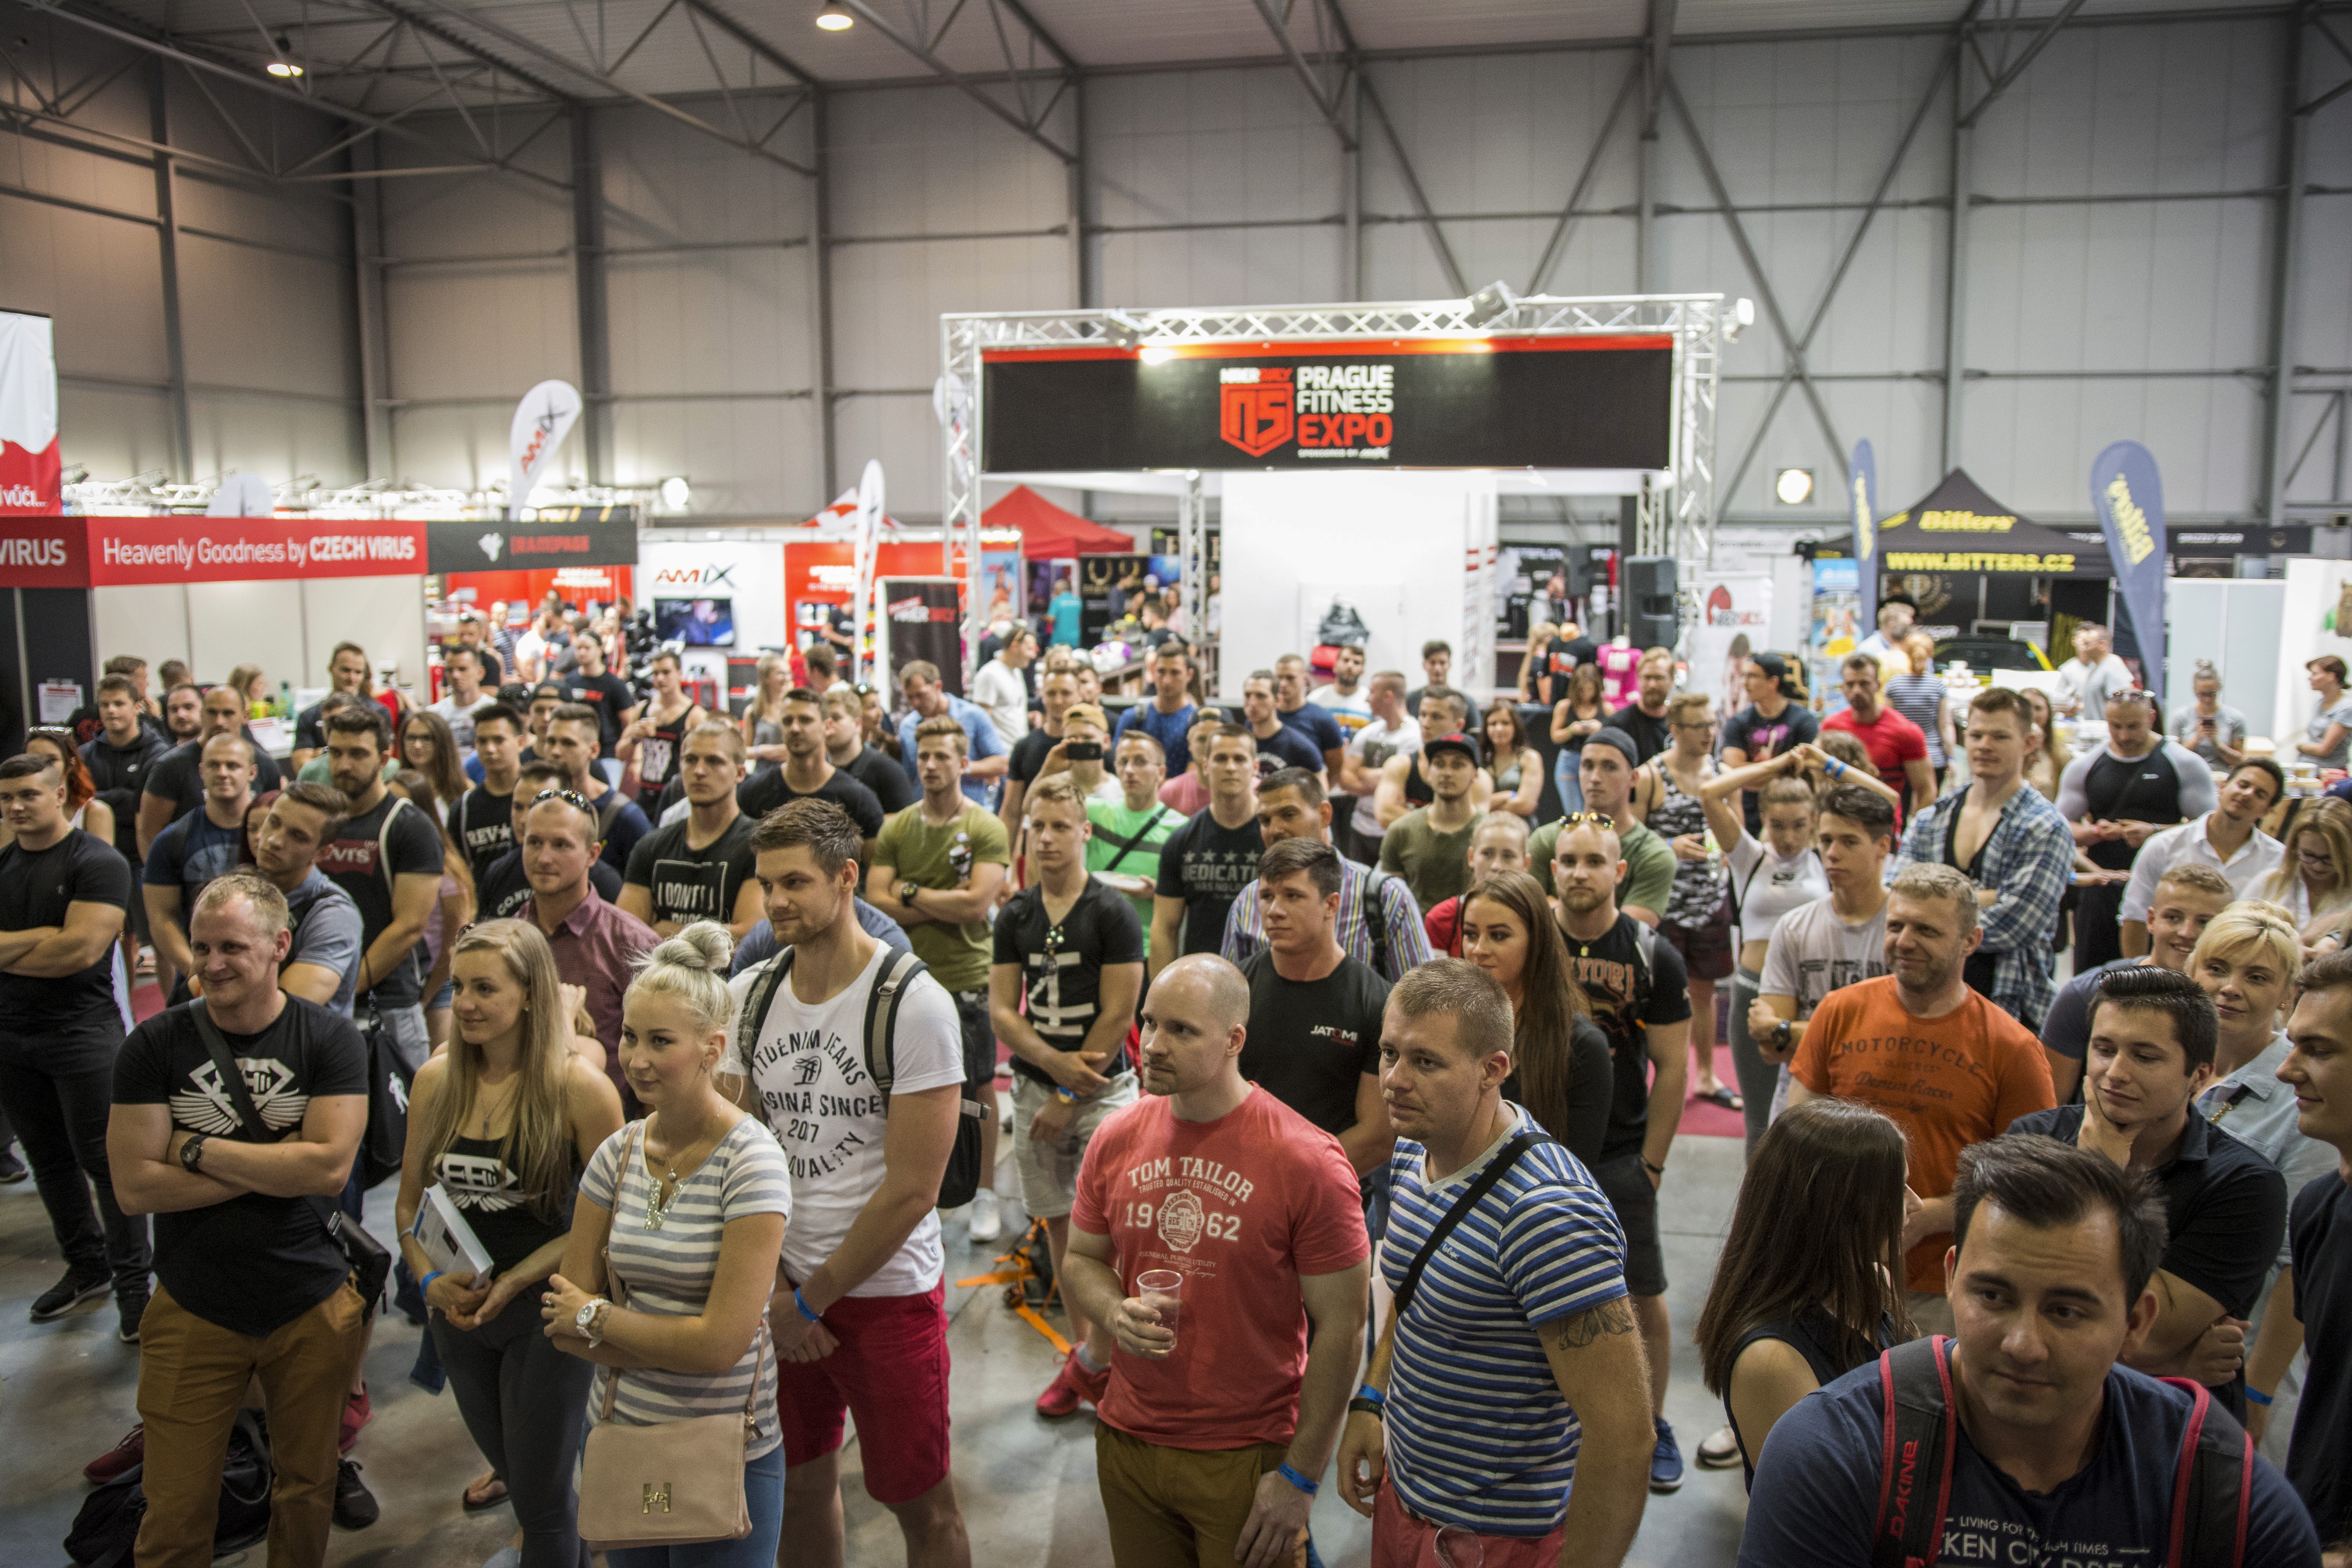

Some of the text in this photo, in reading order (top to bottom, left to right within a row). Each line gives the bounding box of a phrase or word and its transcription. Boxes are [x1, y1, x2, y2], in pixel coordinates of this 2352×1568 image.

[1297, 365, 1394, 390] PRAGUE
[1297, 390, 1394, 414] FITNESS
[1297, 413, 1394, 447] EXPO
[1298, 449, 1345, 458] SPONSORED
[1347, 449, 1358, 457] BY
[103, 535, 416, 571] Heavenly Goodness by CZECH VIRUS
[1886, 552, 2075, 572] WWW.BITTERS.CZ
[655, 562, 739, 589] AMIX
[1310, 1025, 1357, 1042] JATOMI
[824, 1032, 865, 1085] JEANS
[1842, 1036, 1984, 1076] MOTORCYCLE
[820, 1095, 881, 1117] SINCE
[1127, 1156, 1254, 1203] TOM TAILOR
[1139, 1178, 1237, 1207] TRUSTED QUALITY ESTABLISHED IN
[1125, 1202, 1153, 1229] 19
[1207, 1212, 1242, 1242] 62
[1889, 1439, 1919, 1540] DAKINE
[1938, 1533, 1996, 1560] KEN
[1960, 1516, 1999, 1530] LIVING
[2002, 1523, 2024, 1536] FOR
[2073, 1543, 2109, 1555] TIMES
